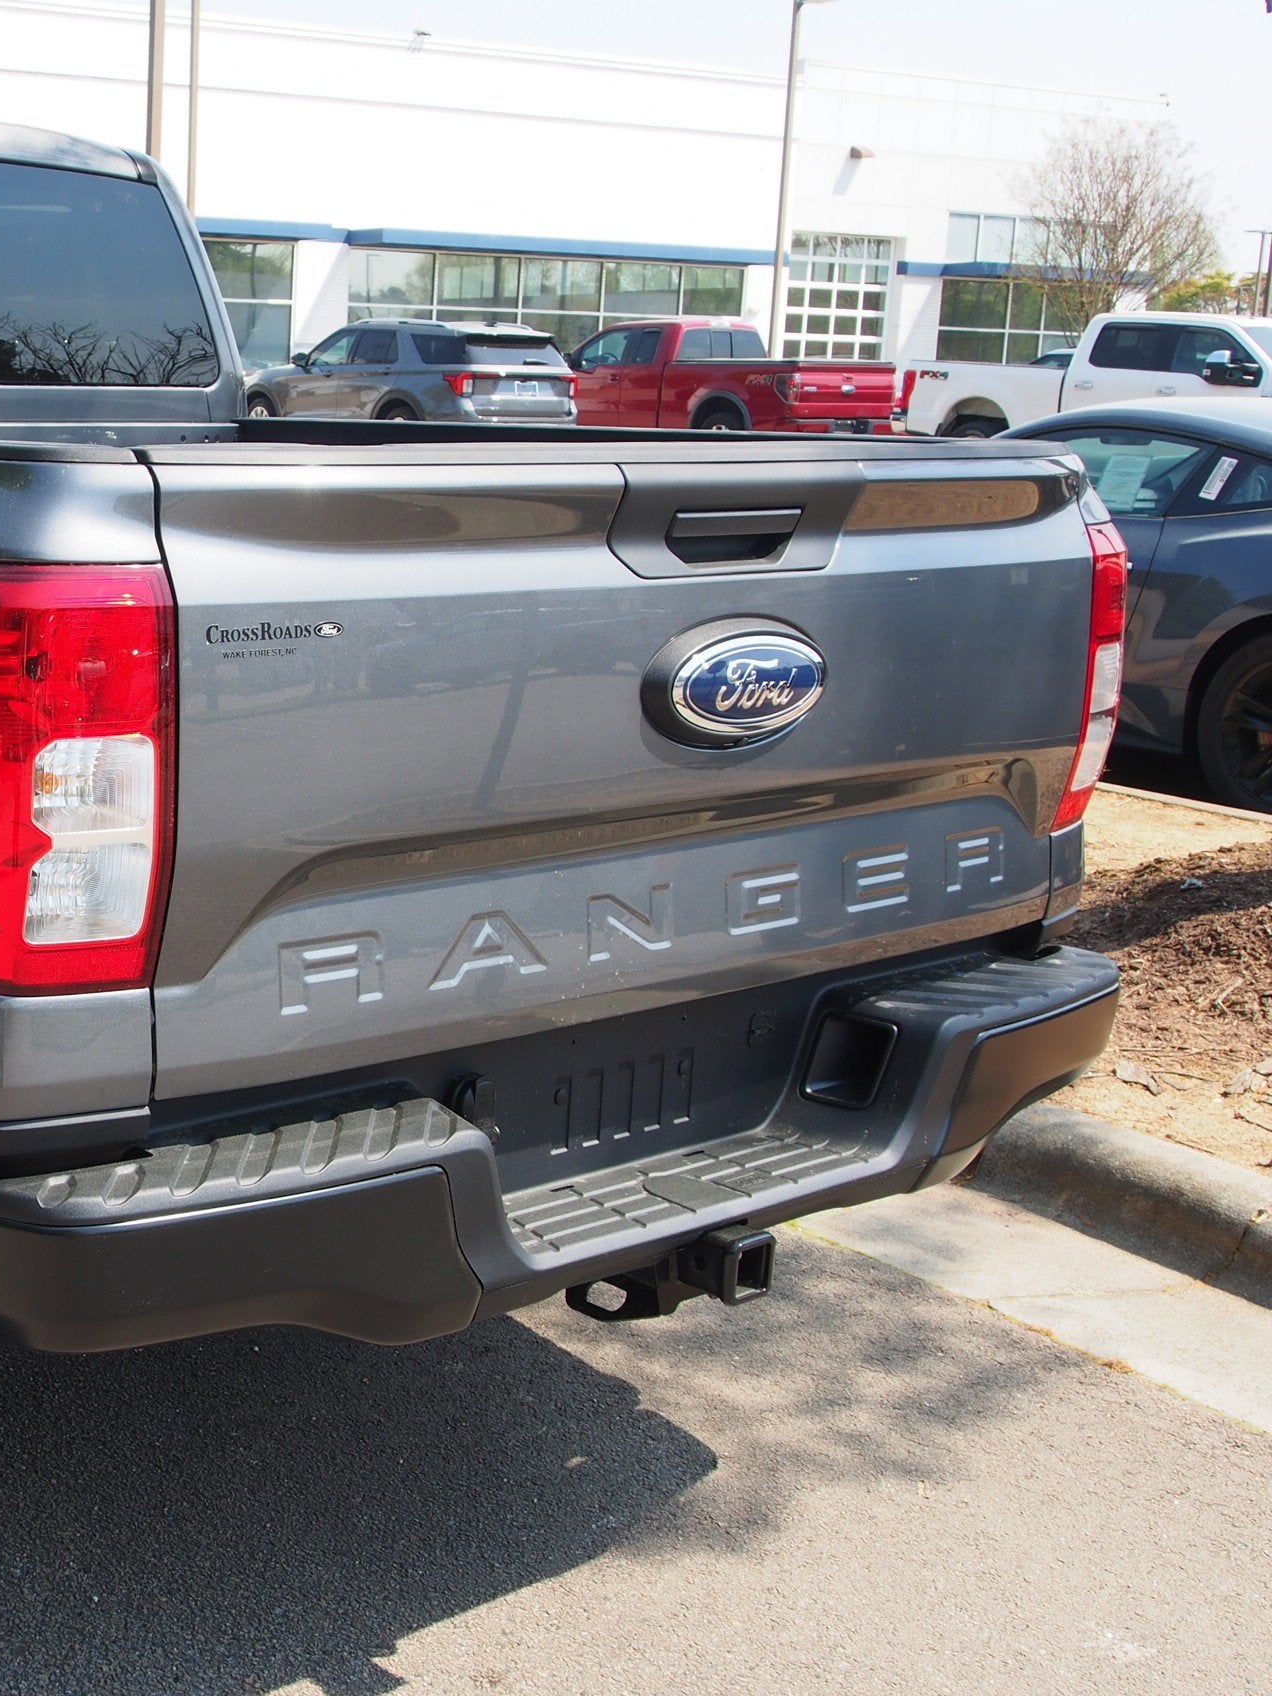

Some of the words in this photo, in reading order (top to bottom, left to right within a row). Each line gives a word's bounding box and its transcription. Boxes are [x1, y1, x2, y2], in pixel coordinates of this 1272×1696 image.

[919, 370, 949, 380] FX4
[222, 650, 247, 659] WAKE
[249, 648, 284, 657] FOREST,
[286, 647, 297, 656] NC
[715, 658, 798, 712] Ford
[278, 826, 1005, 1016] RANGER
